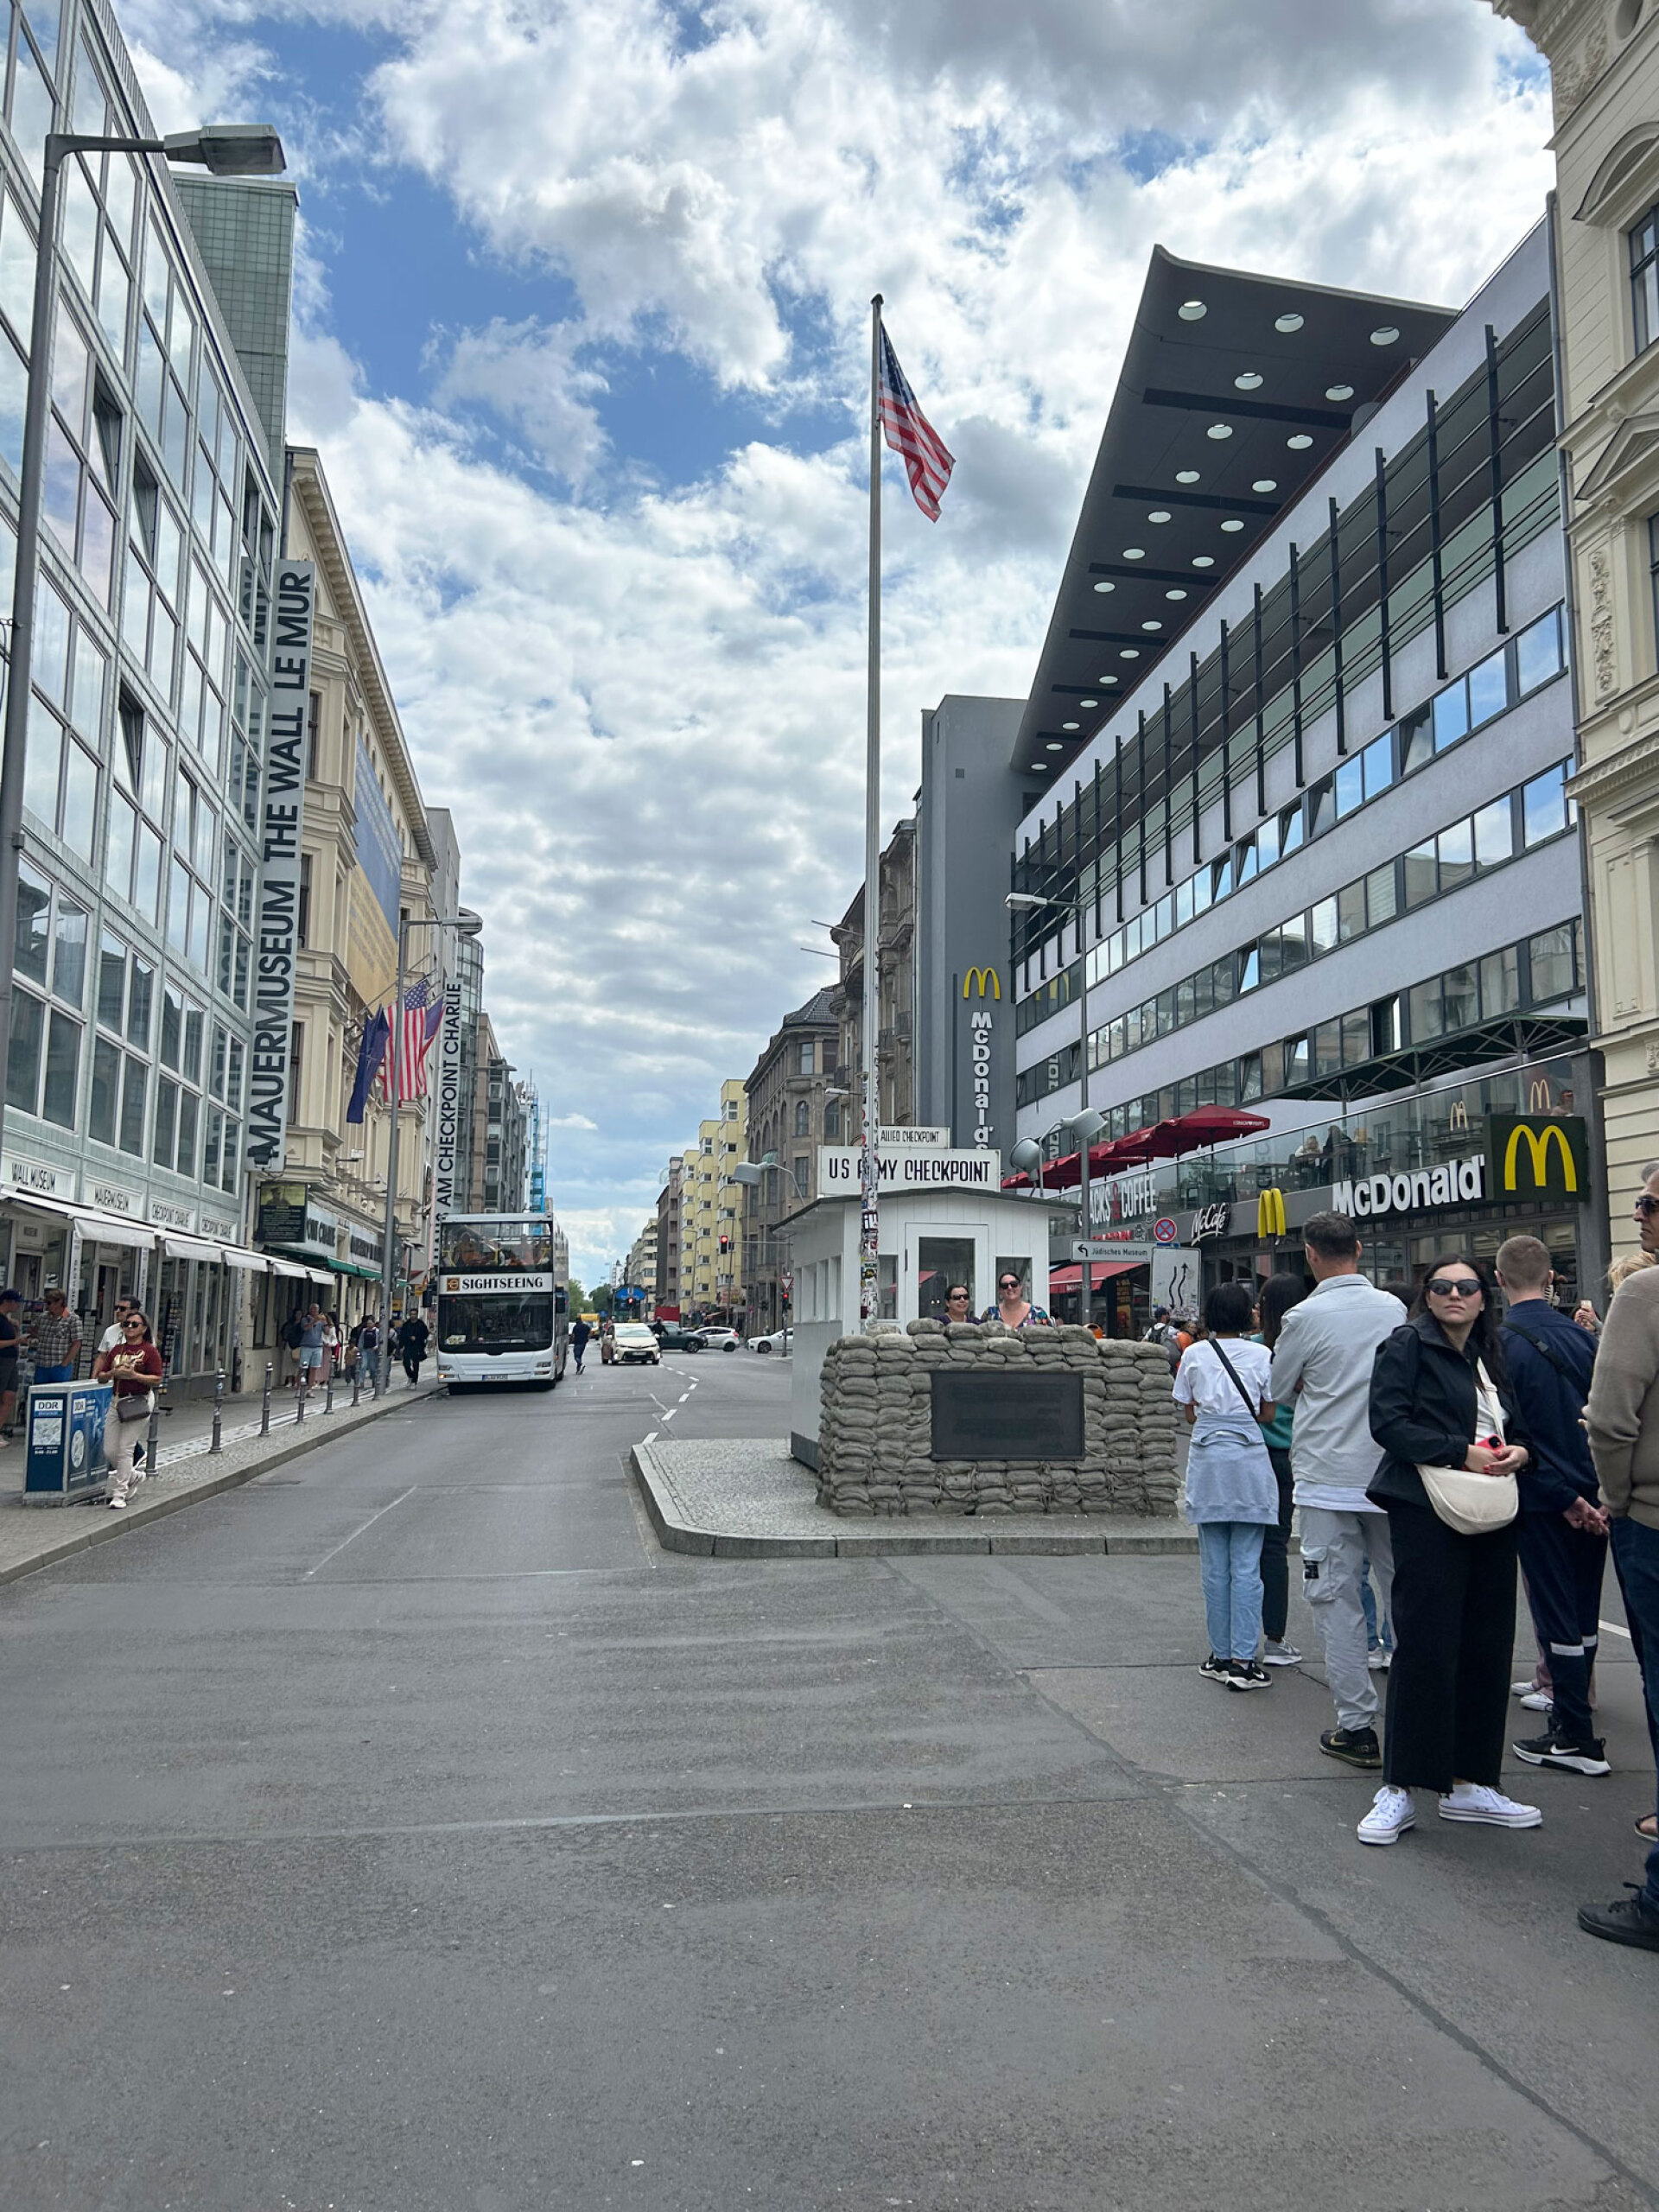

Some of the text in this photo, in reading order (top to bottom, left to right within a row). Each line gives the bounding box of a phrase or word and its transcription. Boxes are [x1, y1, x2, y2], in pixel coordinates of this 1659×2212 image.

[248, 572, 311, 1159] MAUERMUSEUM THE WALL LE MUR
[443, 983, 461, 1055] CHARLIE
[439, 1060, 458, 1172] CHECKPOINT
[880, 1129, 940, 1143] ALLIED CHECKPOINT
[829, 1157, 990, 1182] US AMY CHECKPOINT
[1332, 1154, 1485, 1217] McDonald'
[437, 1178, 452, 1207] AM
[1077, 1185, 1111, 1227] SACKS
[1121, 1173, 1157, 1218] COFFEE
[1191, 1202, 1227, 1236] McCafé
[462, 1277, 543, 1289] SIGHTSEEING
[38, 1402, 59, 1410] DDR
